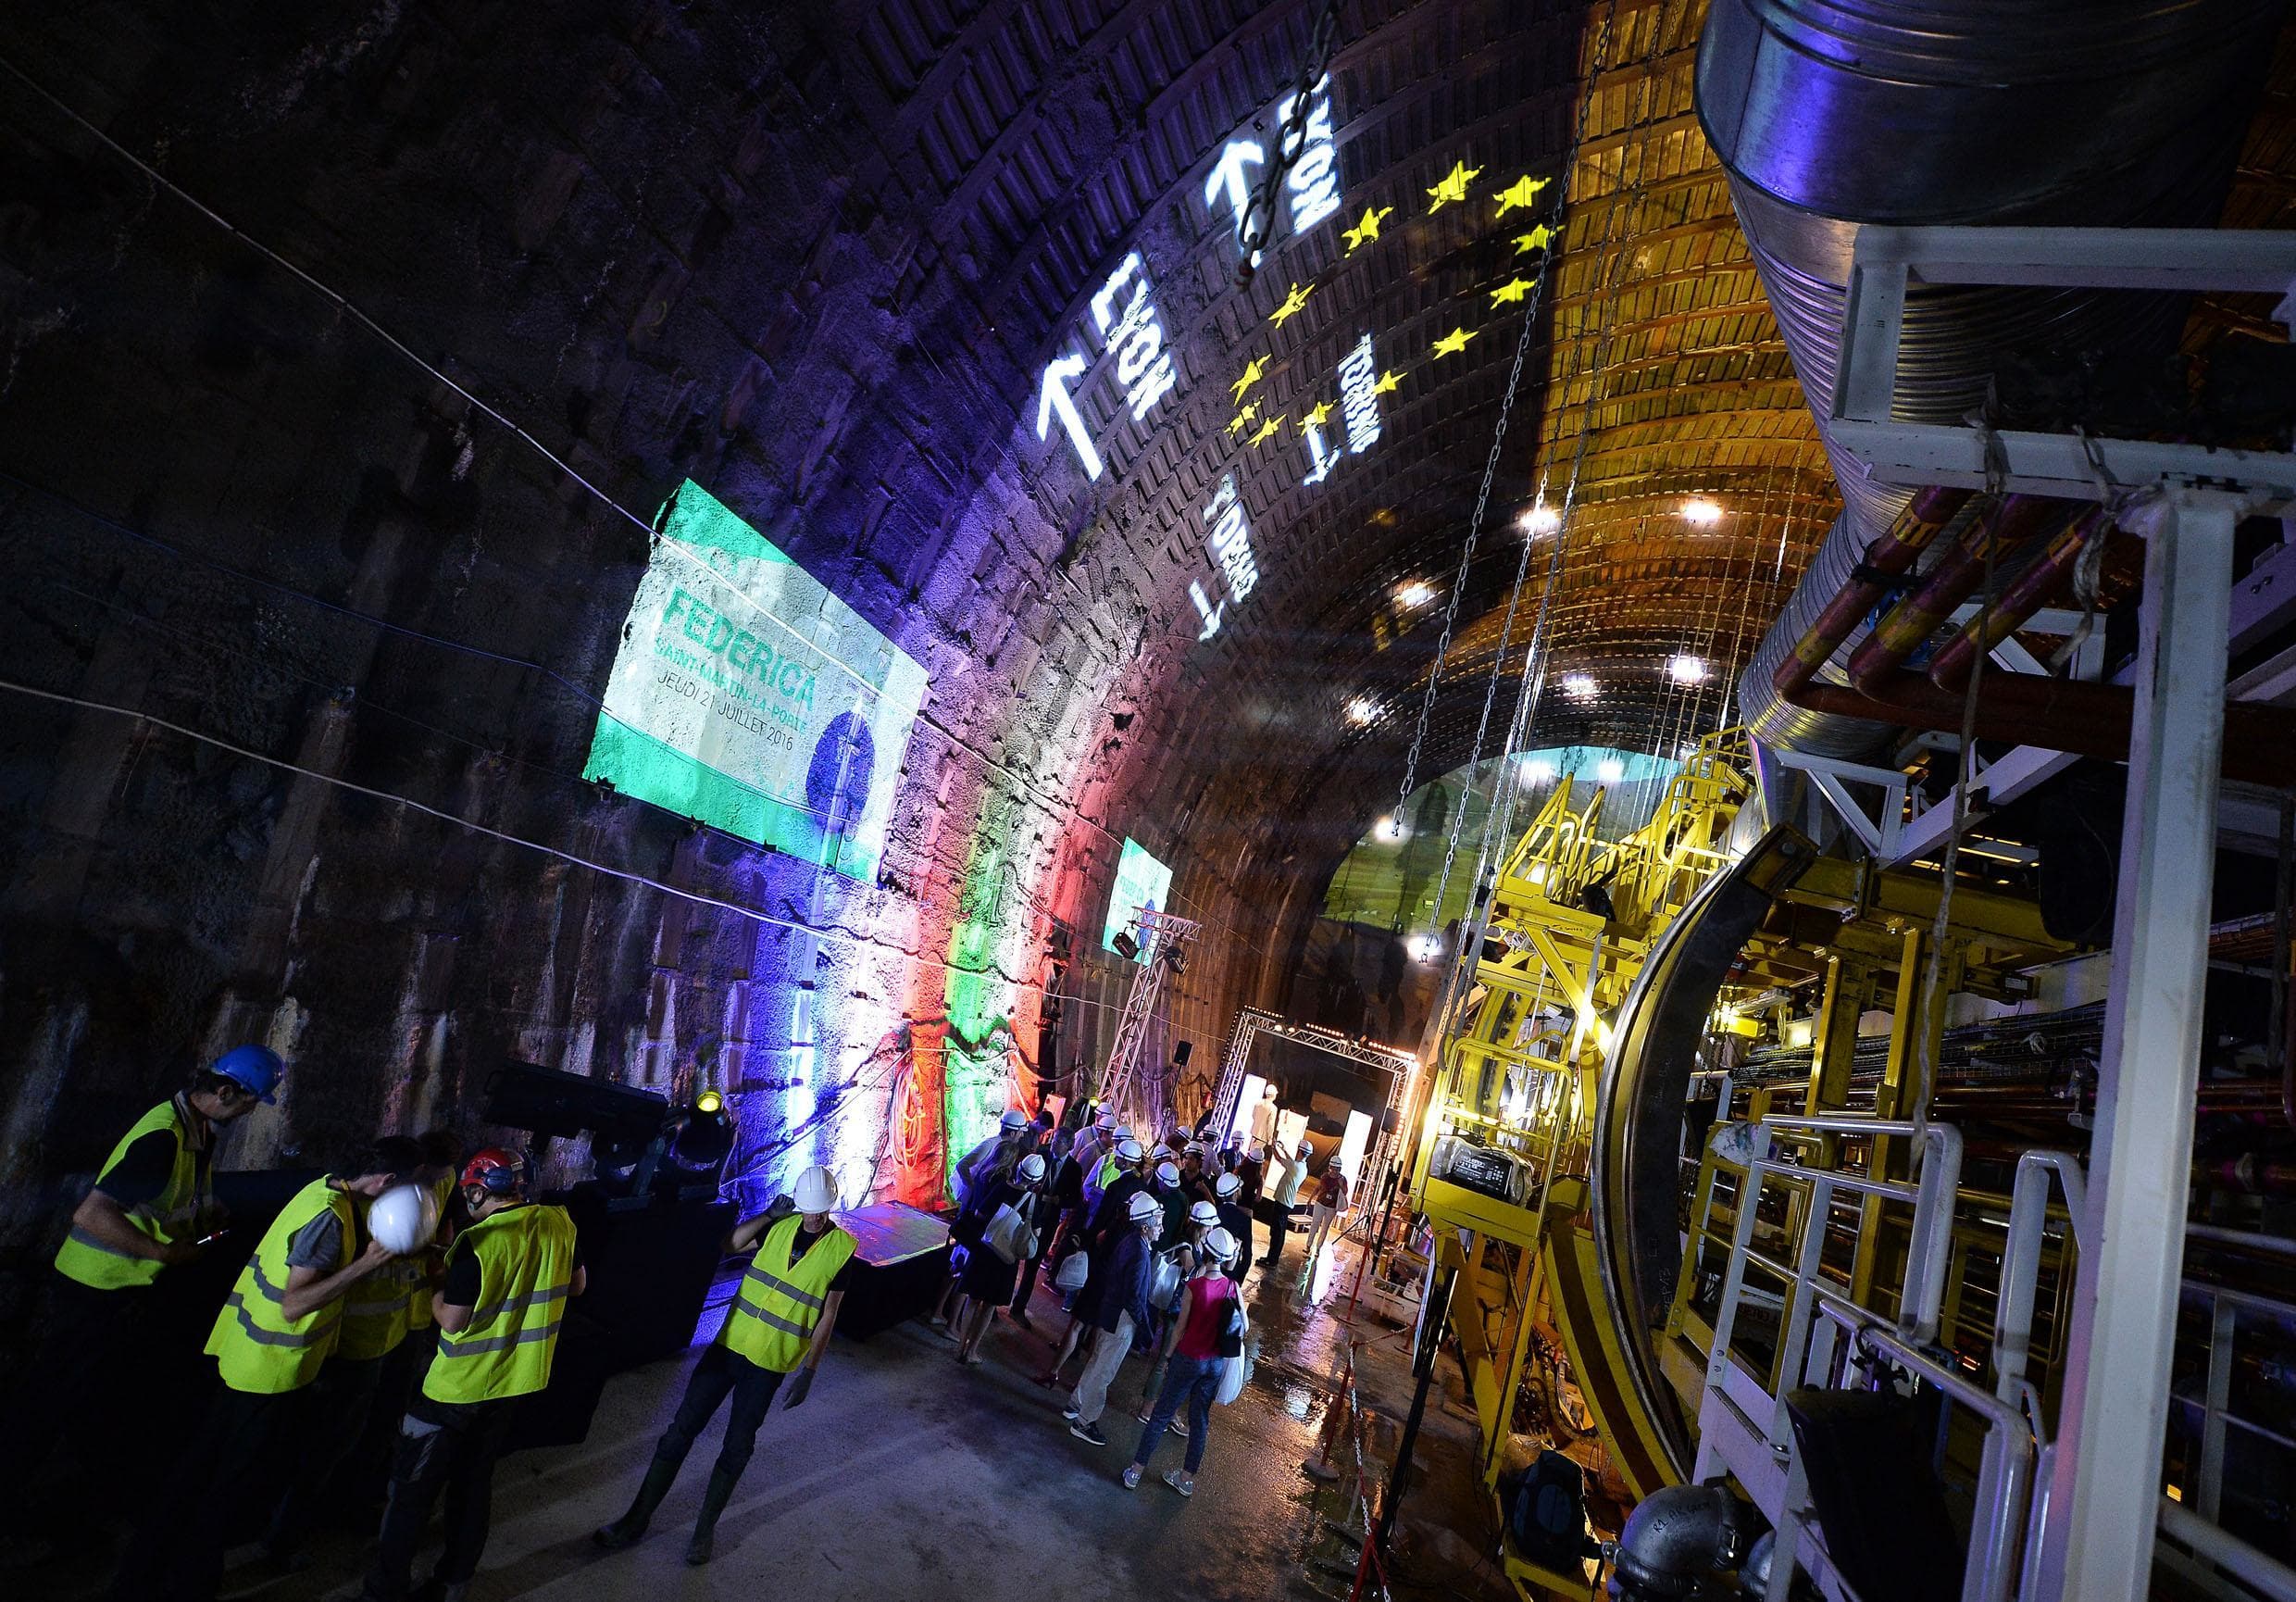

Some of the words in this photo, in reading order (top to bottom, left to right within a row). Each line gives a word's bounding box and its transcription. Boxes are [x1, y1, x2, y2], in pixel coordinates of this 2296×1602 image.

[1091, 252, 1176, 420] LYON
[657, 670, 701, 700] JEUDI
[700, 691, 716, 710] 21
[718, 701, 767, 736] JUILLET
[767, 726, 793, 751] 2016
[662, 585, 816, 712] FEDERICA
